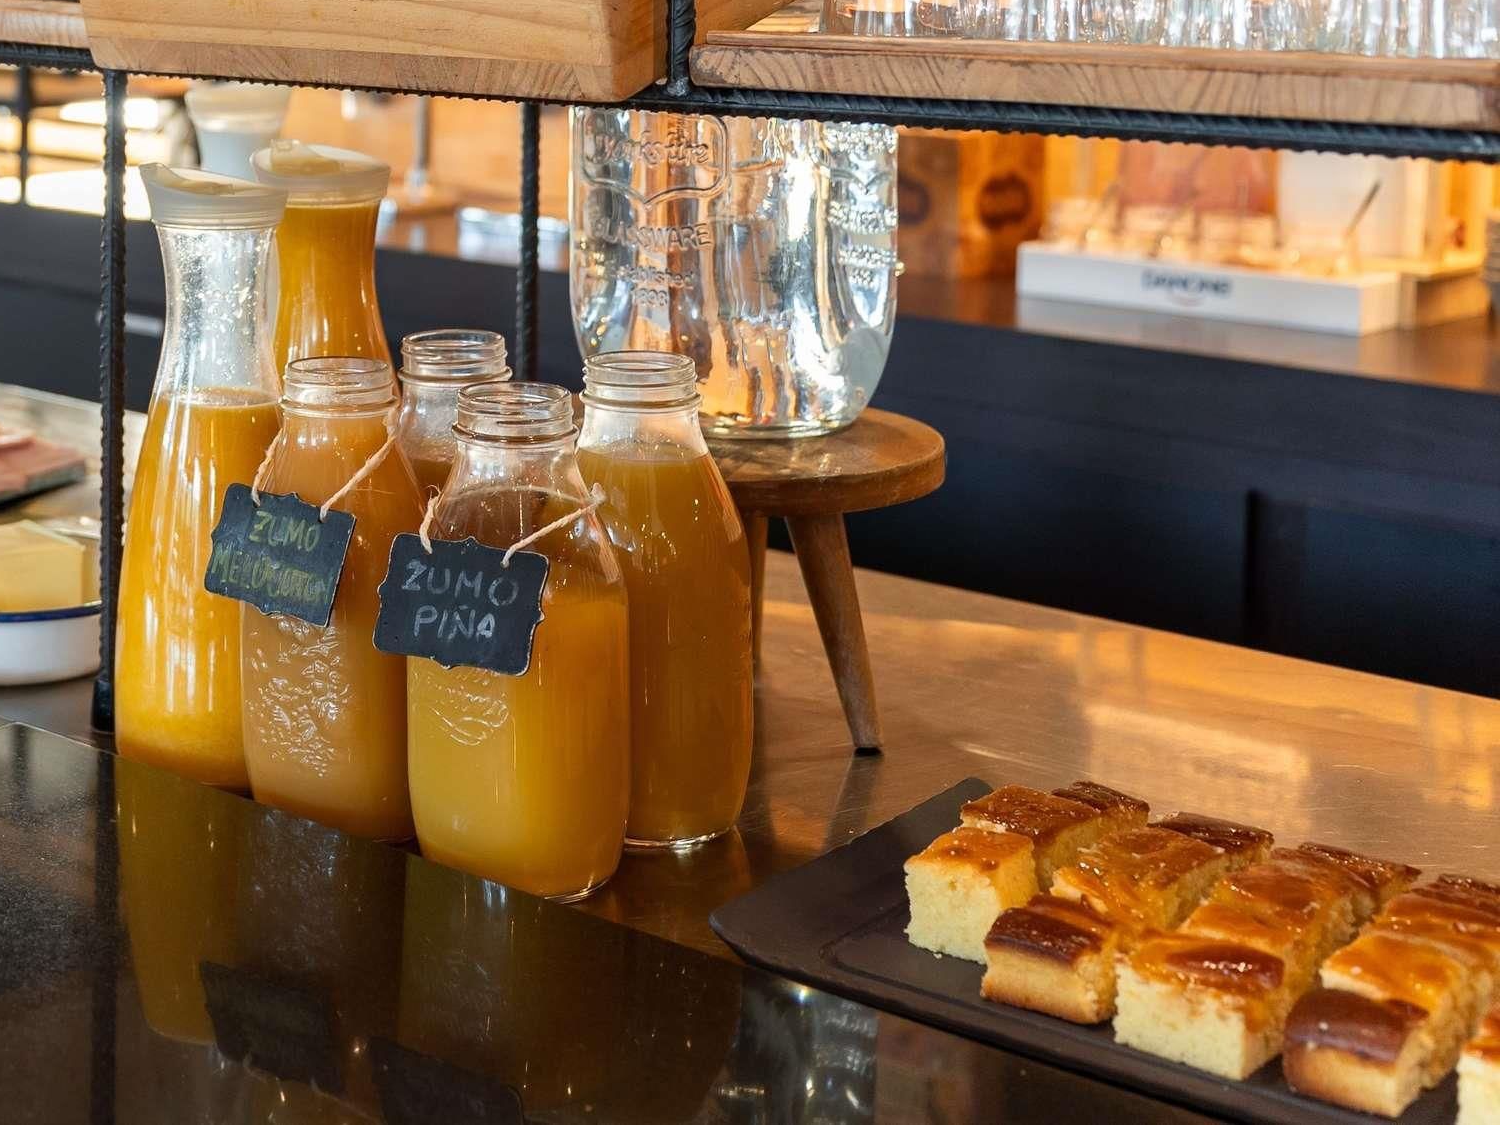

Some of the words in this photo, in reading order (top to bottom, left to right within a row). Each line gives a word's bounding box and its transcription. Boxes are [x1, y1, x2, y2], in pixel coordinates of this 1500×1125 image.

[249, 510, 322, 553] ZUMO
[401, 558, 520, 607] ZUMO
[413, 604, 496, 640] PIÑA
